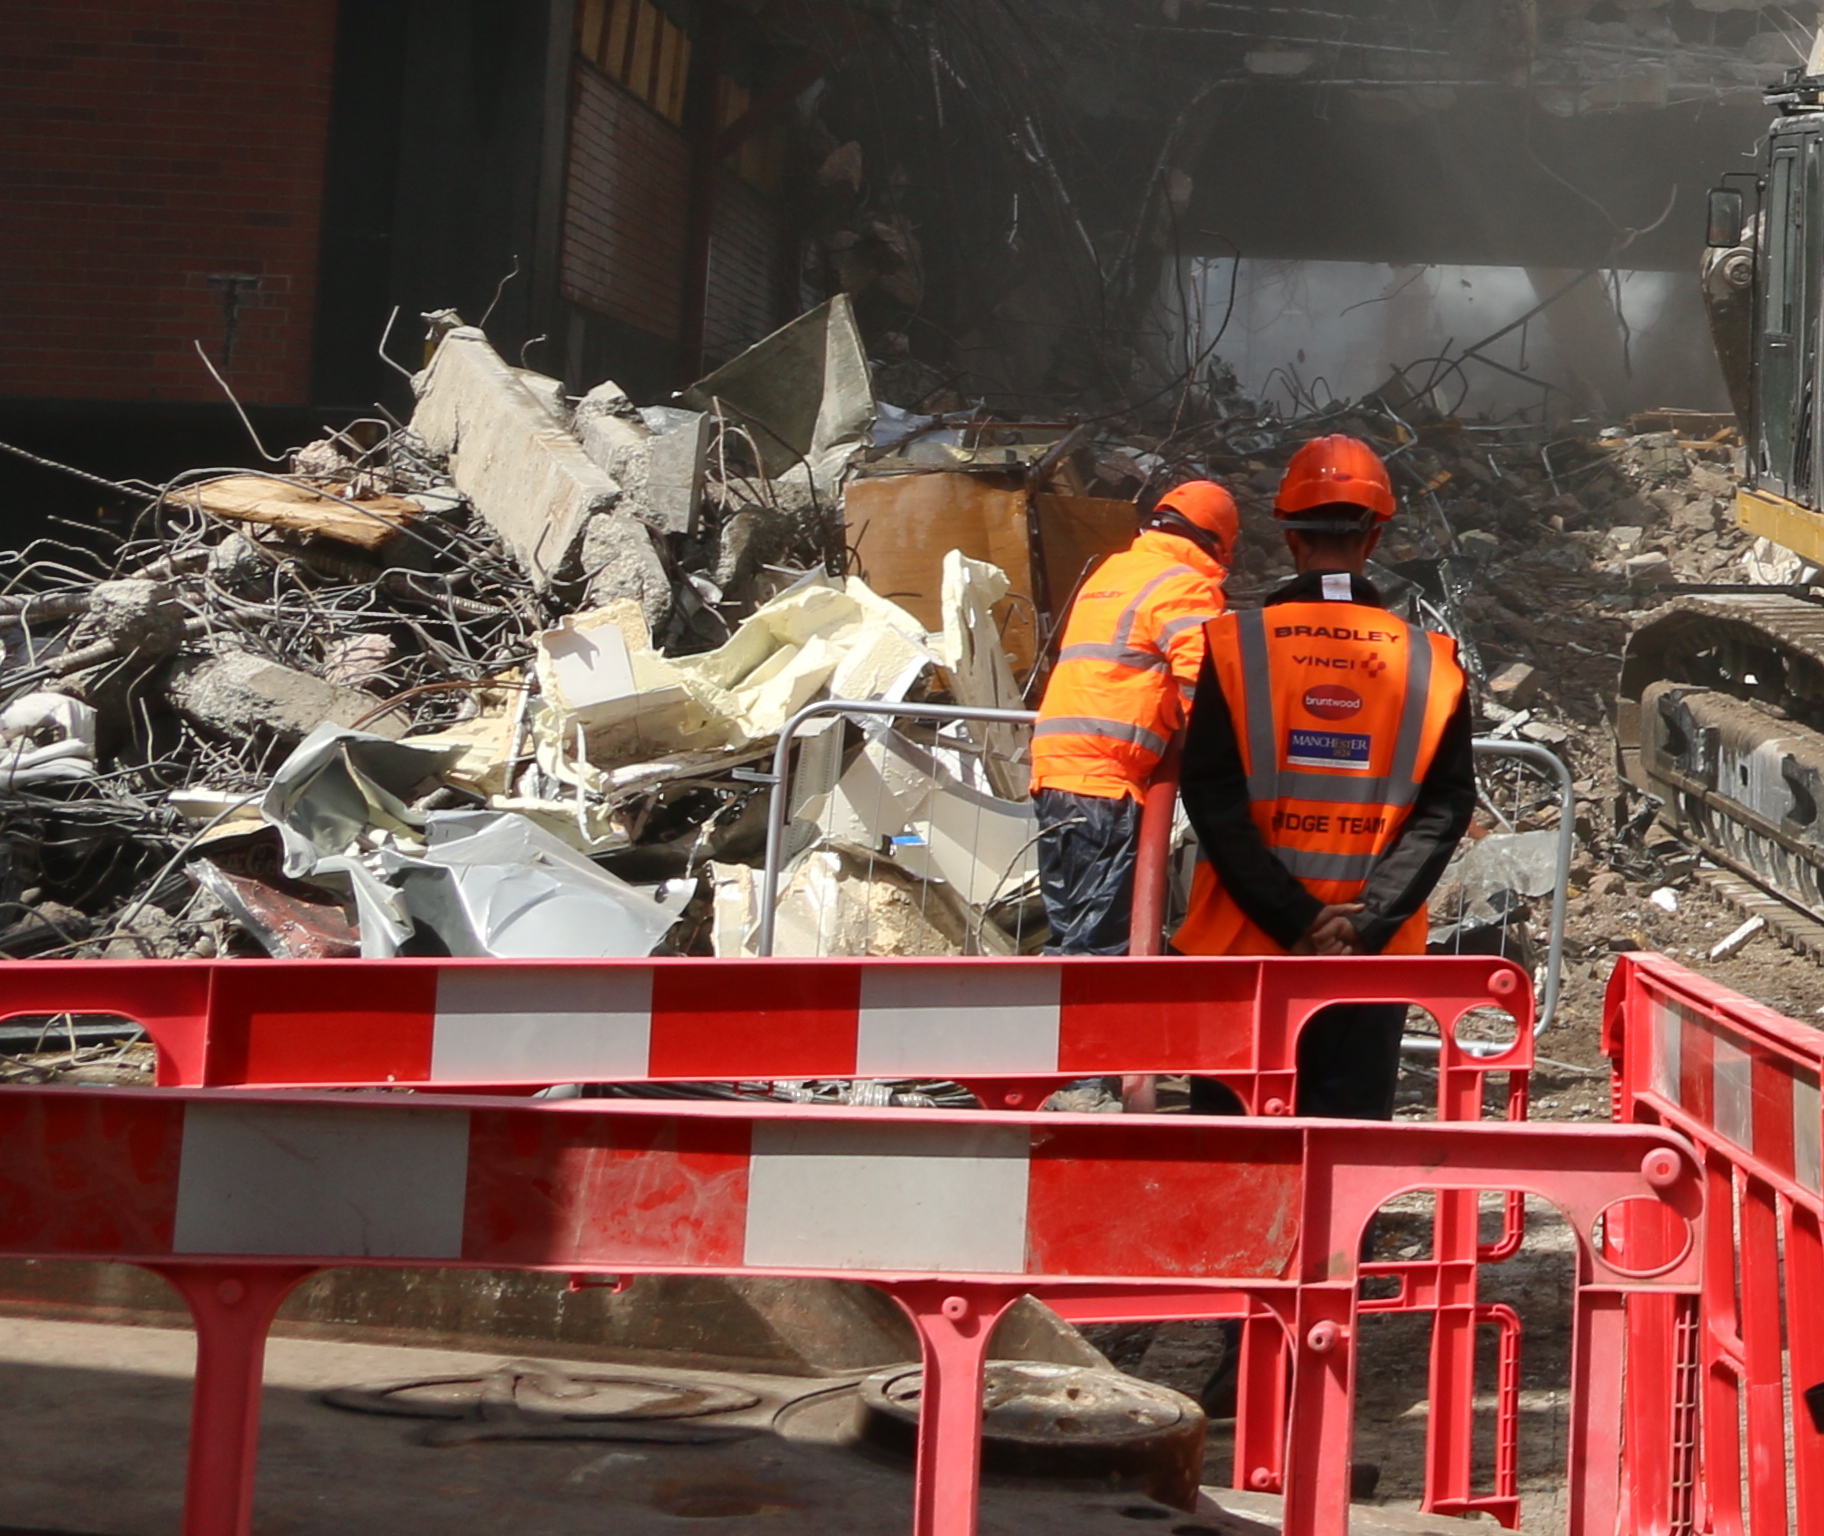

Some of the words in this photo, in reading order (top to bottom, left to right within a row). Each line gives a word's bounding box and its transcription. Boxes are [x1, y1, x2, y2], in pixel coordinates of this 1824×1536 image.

[1274, 625, 1400, 643] BRADLEY
[1292, 654, 1355, 670] VINCI
[1305, 695, 1361, 709] bruntwood
[1291, 734, 1368, 751] MANCHESTER
[1337, 816, 1386, 834] TEAM
